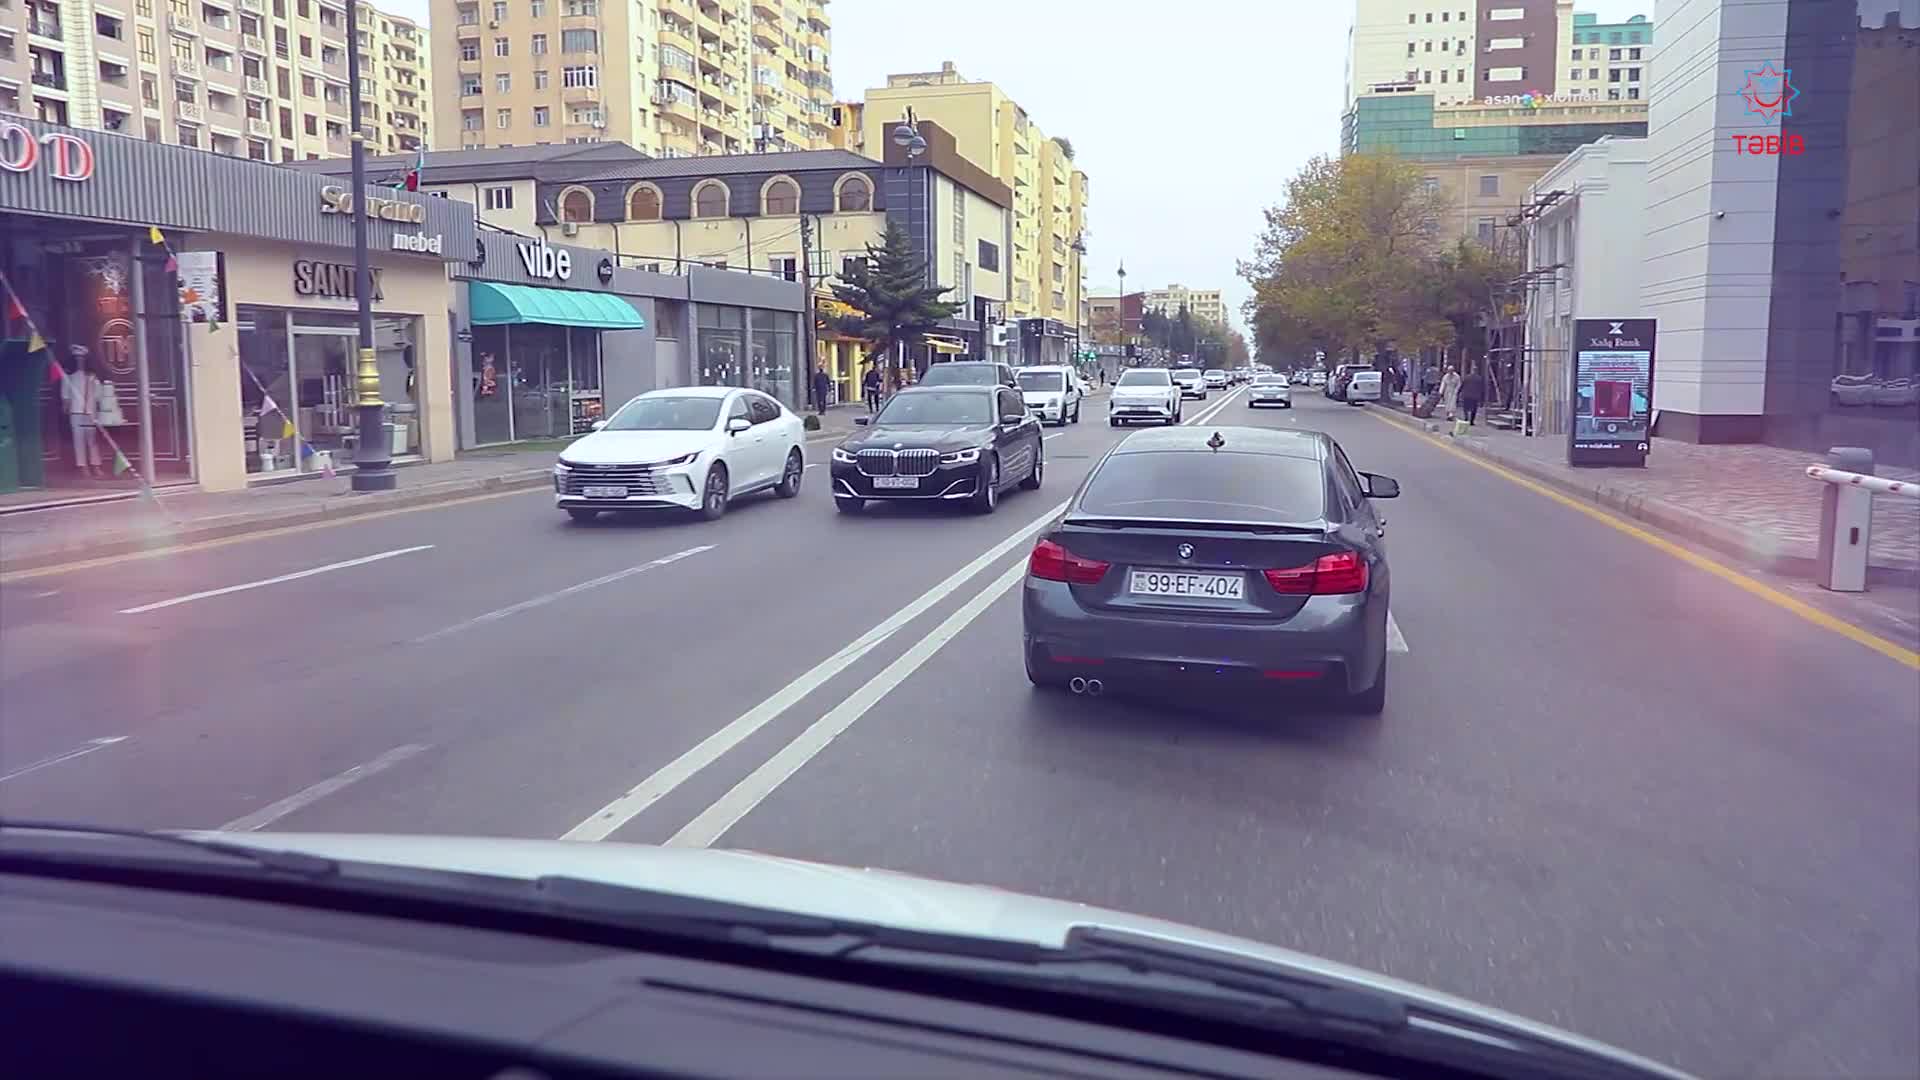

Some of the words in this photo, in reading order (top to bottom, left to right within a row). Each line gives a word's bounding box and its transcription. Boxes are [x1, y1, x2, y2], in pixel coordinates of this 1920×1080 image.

[1484, 95, 1519, 105] asan
[392, 231, 443, 254] mebel
[516, 237, 571, 280] vibe
[294, 260, 384, 300] SANTX
